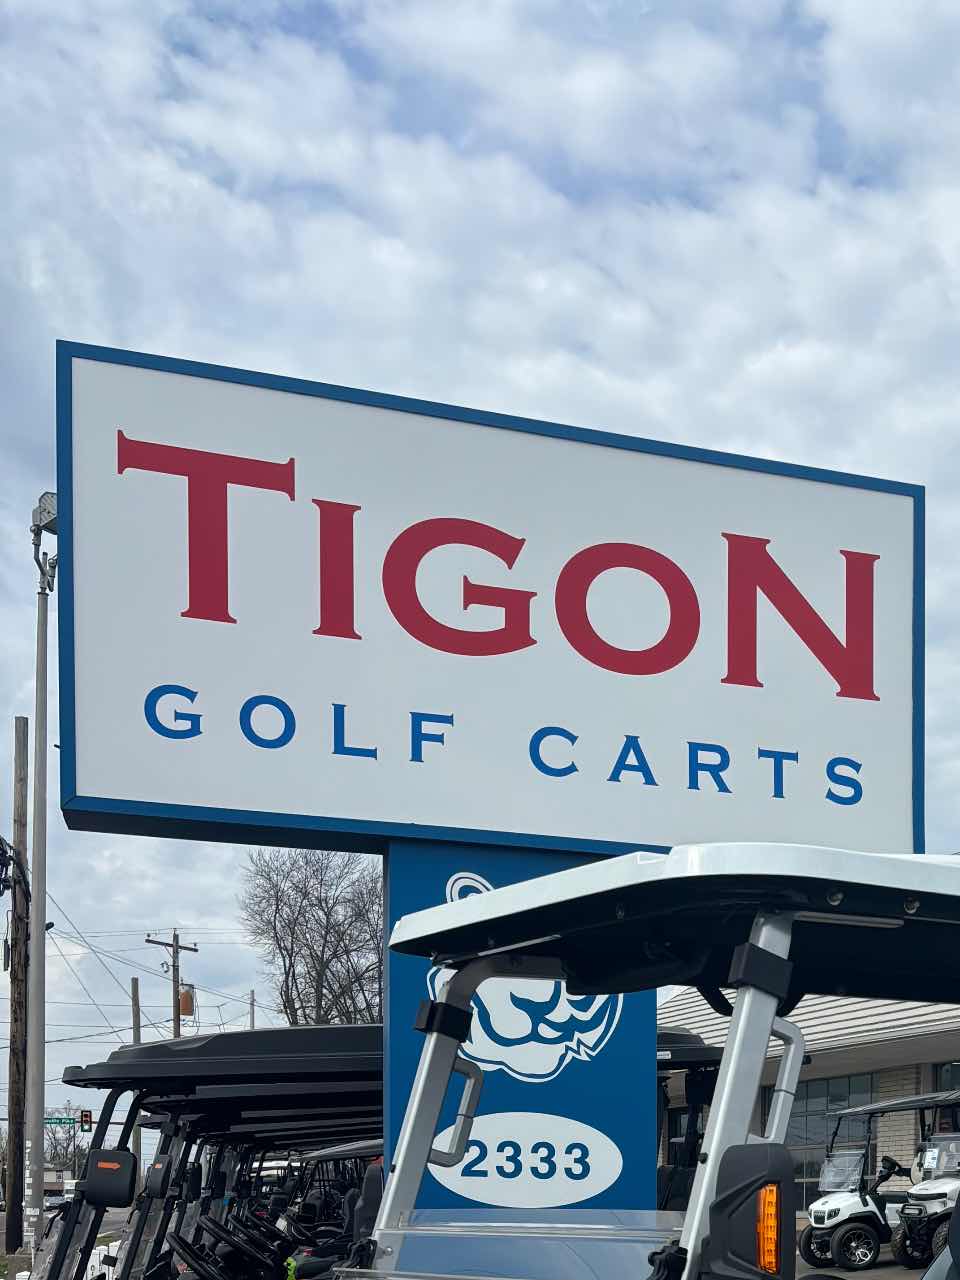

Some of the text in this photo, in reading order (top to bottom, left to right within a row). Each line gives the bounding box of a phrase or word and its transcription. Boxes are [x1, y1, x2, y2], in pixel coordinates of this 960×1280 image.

[117, 429, 881, 702] TIGON
[143, 684, 864, 806] GOLF CARTS
[460, 1139, 591, 1181] 2333
